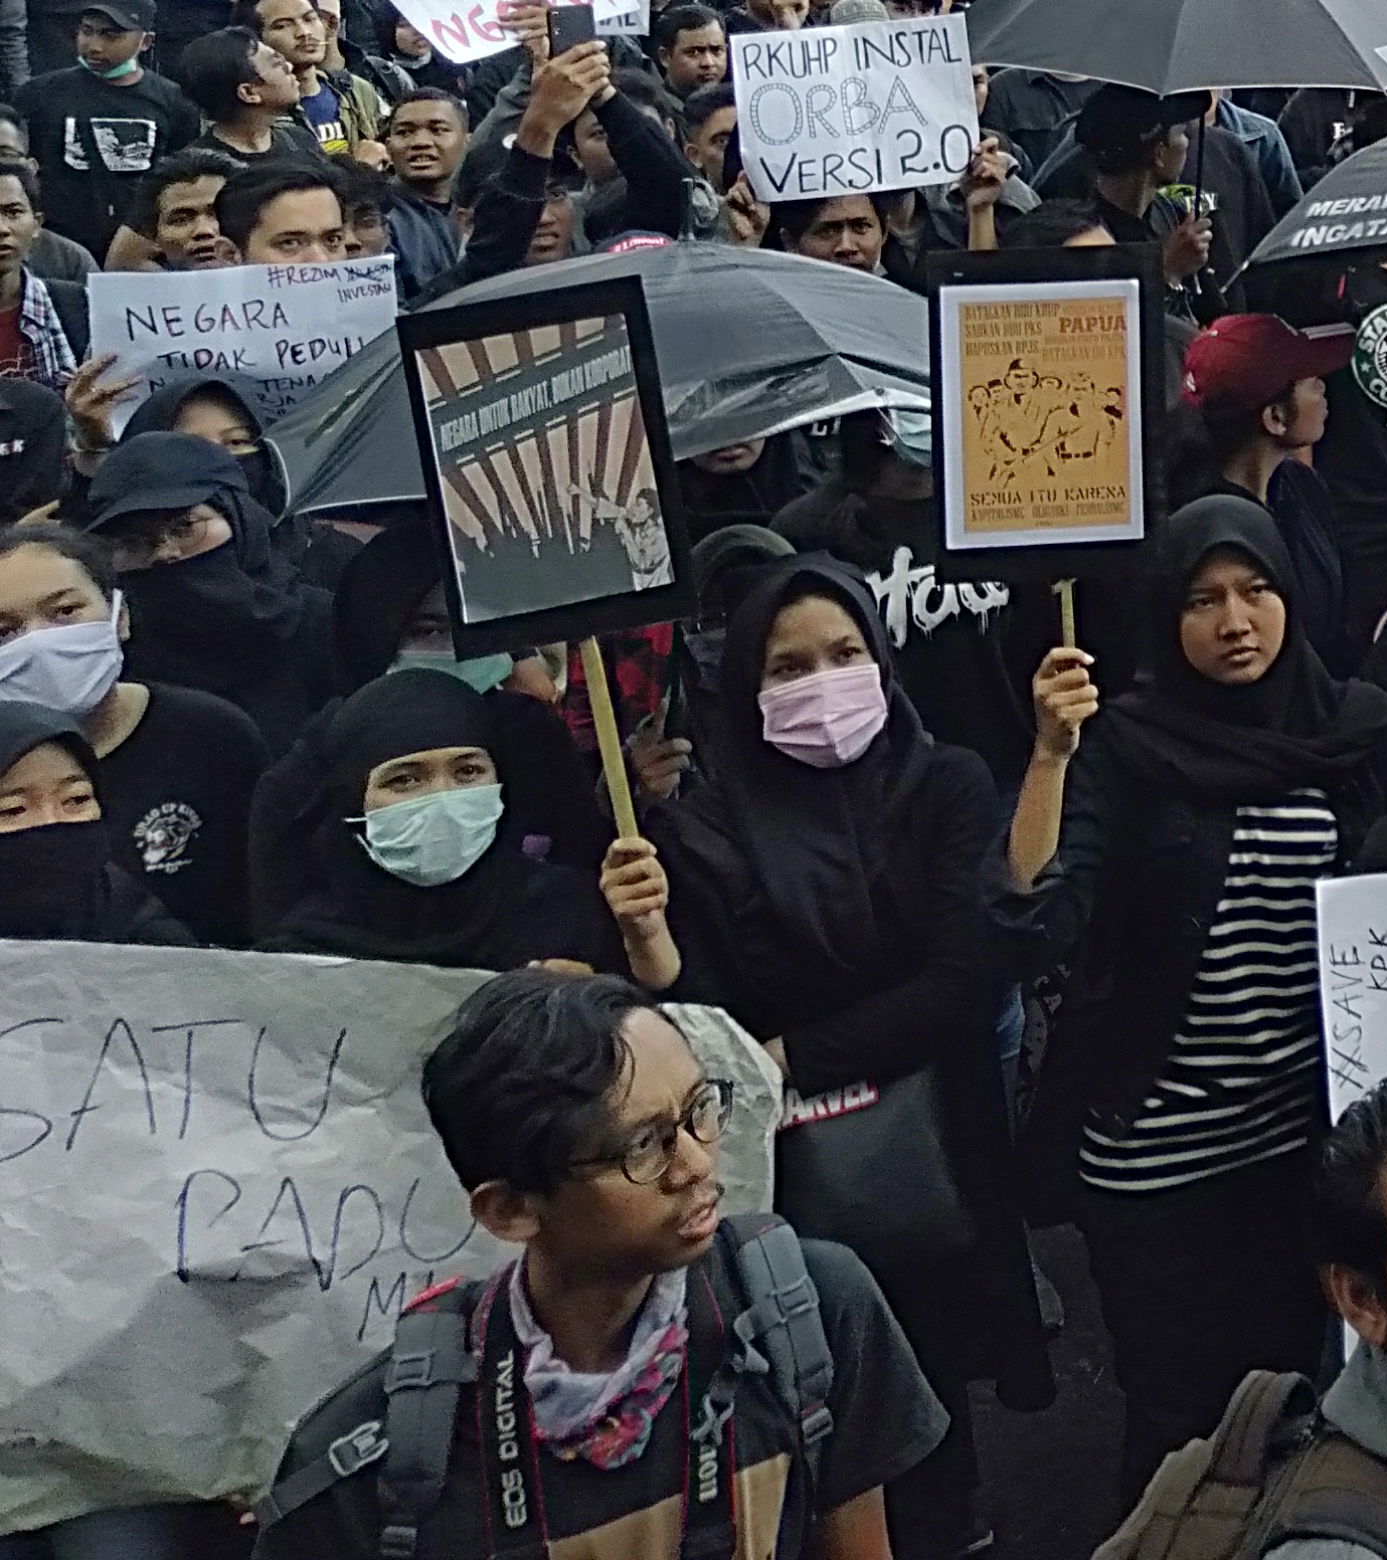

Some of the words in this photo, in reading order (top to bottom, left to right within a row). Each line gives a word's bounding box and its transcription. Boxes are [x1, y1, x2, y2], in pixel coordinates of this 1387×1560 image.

[742, 37, 837, 81] RKUHP
[853, 27, 962, 72] INSTAL
[750, 74, 929, 147] ORBA
[759, 147, 884, 195] VERSI
[896, 124, 974, 177] 2.0
[125, 298, 291, 342] NEGARA
[1059, 315, 1127, 334] PAPUA
[157, 347, 257, 372] TIDAK
[441, 411, 480, 452] NEGARA
[970, 490, 1022, 507] SEMUA
[1030, 488, 1057, 504] ITU
[1065, 485, 1127, 504] KARENA
[1328, 943, 1369, 1090] #SAVE
[0, 1018, 348, 1162] SATU
[779, 1080, 877, 1130] ARVEL
[174, 1169, 478, 1293] PADU
[496, 1348, 519, 1462] DIGITAL
[501, 1468, 528, 1528] EOS
[698, 1444, 718, 1503] non
